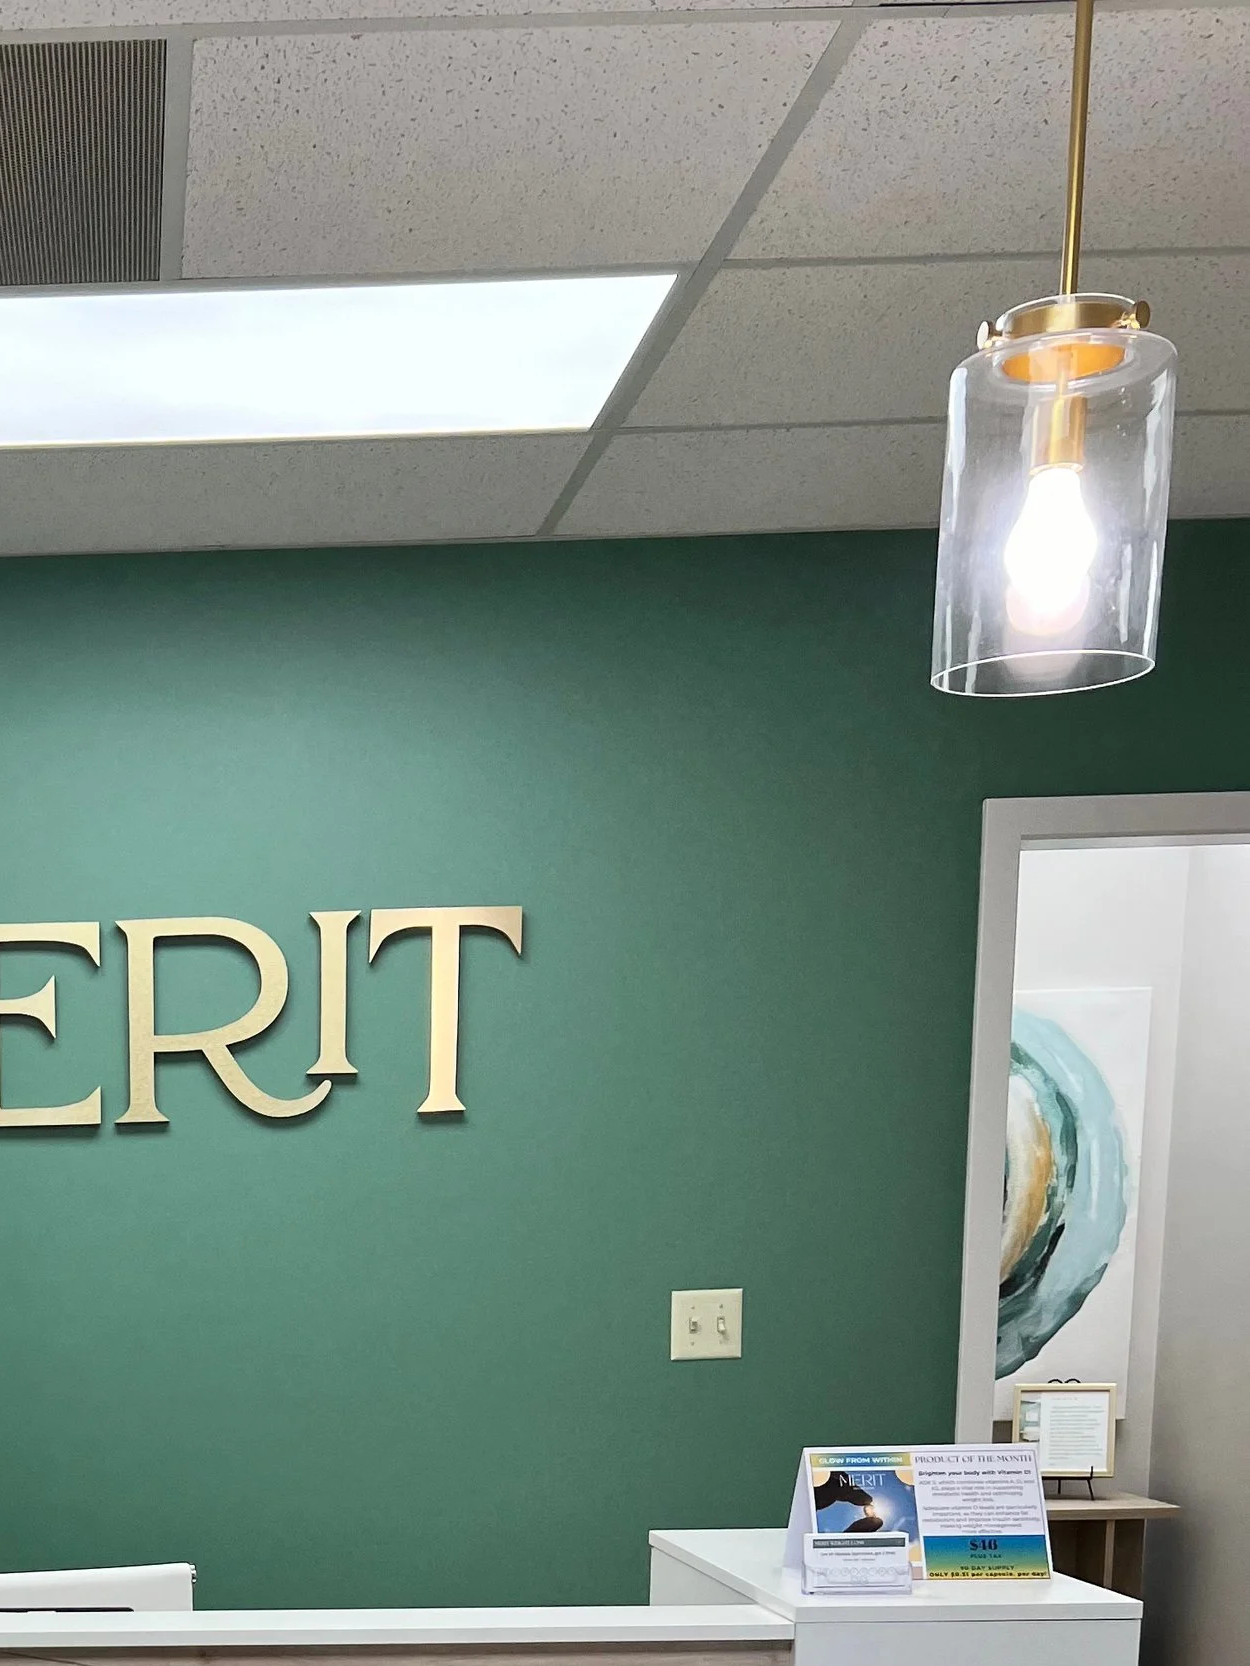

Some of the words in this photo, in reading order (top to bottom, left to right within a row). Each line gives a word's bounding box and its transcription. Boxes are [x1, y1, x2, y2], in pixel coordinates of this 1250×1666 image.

[819, 1457, 844, 1465] GLOW
[915, 1455, 959, 1463] PRODUCT
[962, 1455, 975, 1463] OF
[978, 1455, 994, 1463] THE
[996, 1454, 1032, 1463] MONTH
[839, 1474, 886, 1487] MERIT
